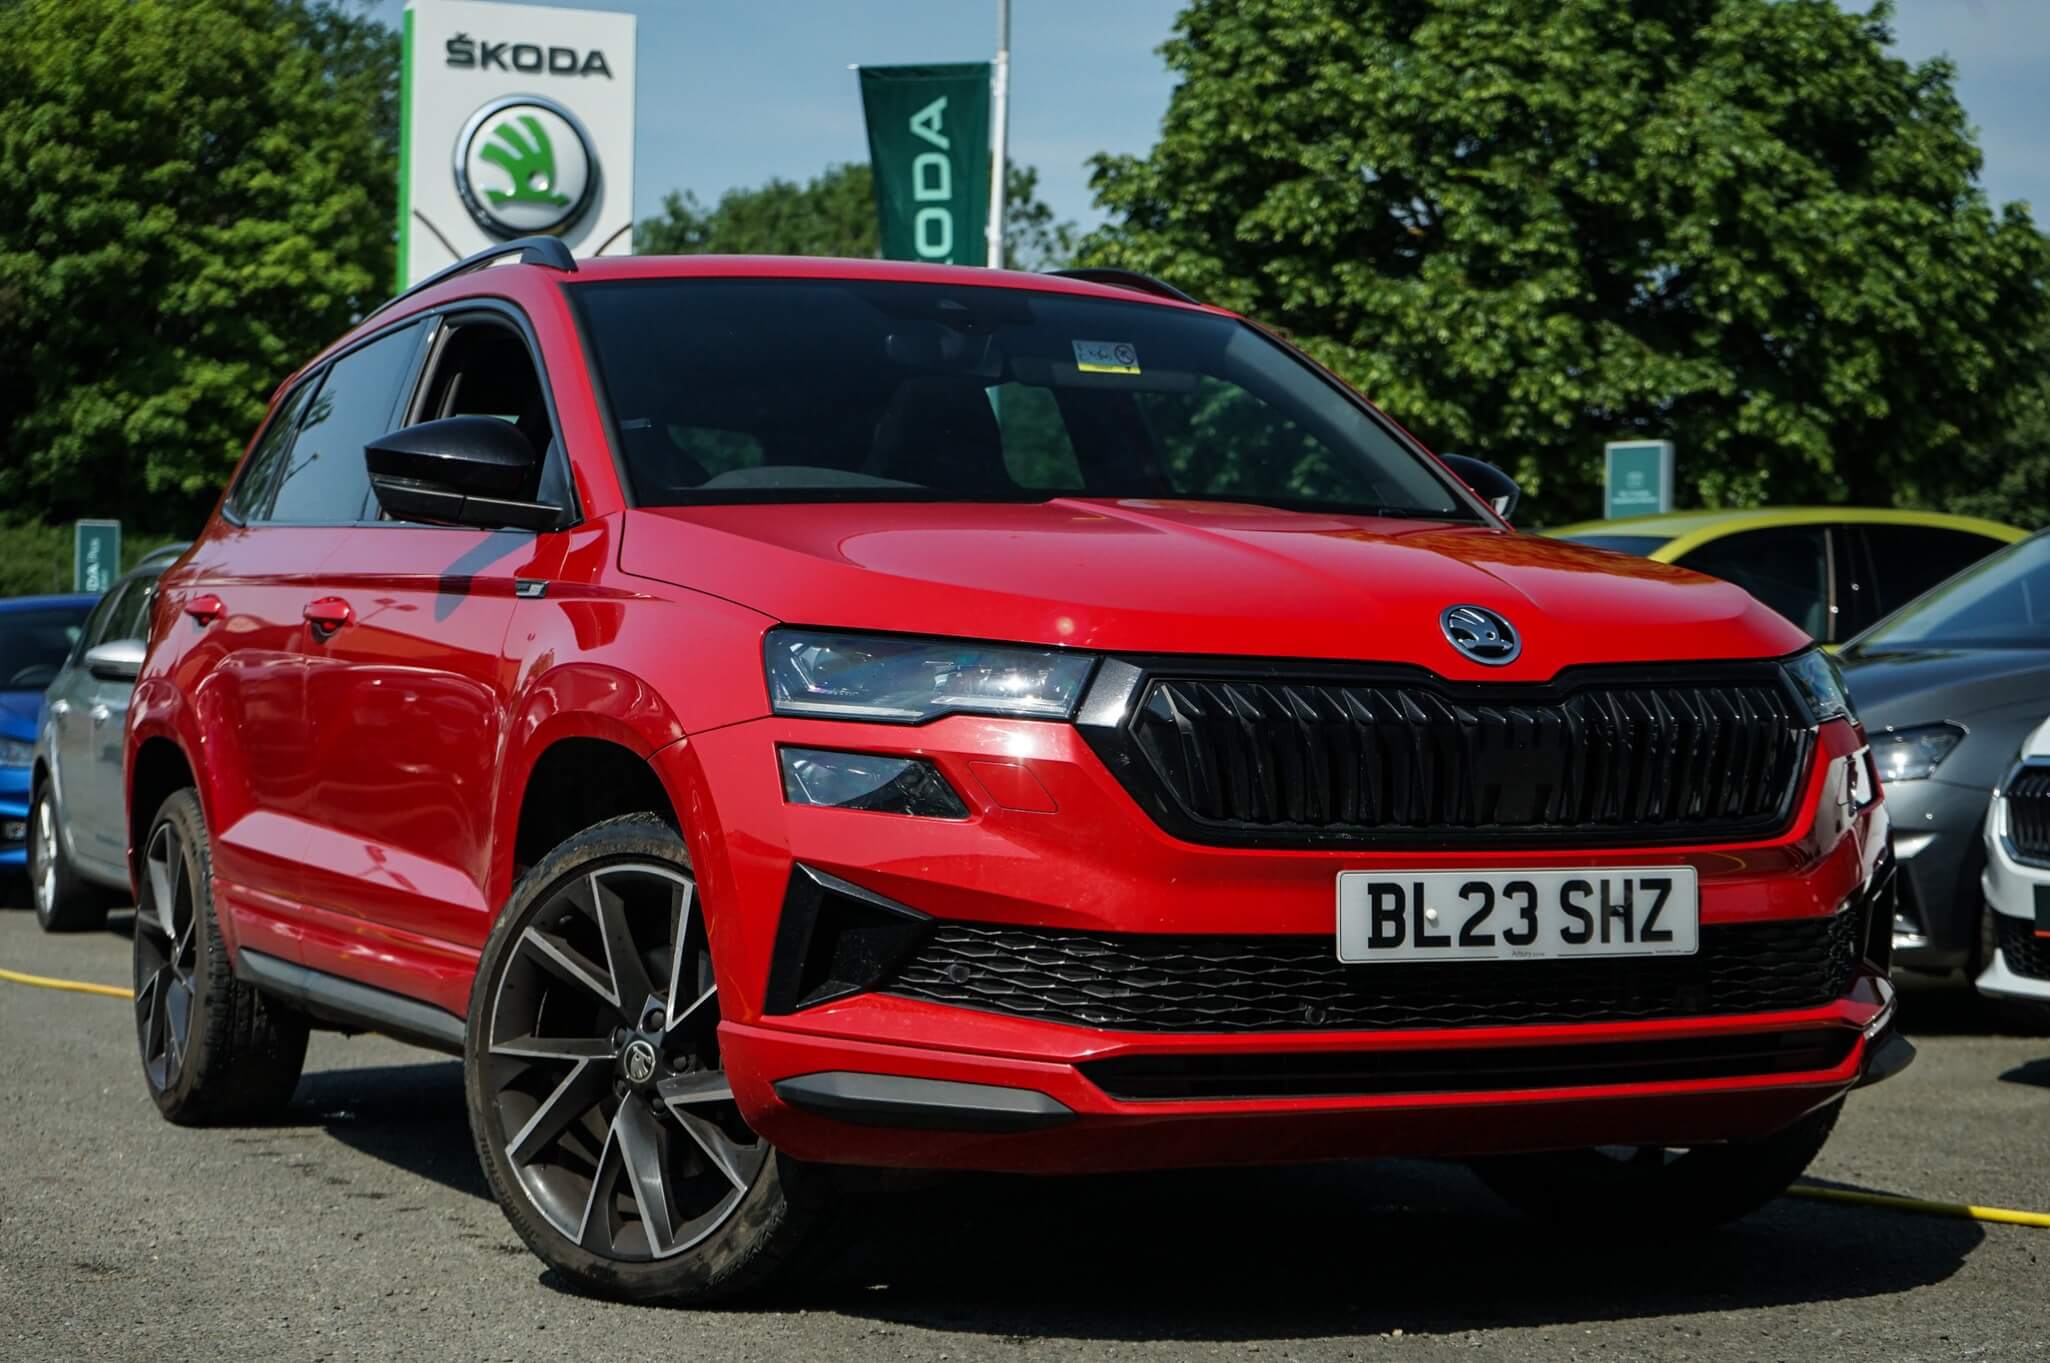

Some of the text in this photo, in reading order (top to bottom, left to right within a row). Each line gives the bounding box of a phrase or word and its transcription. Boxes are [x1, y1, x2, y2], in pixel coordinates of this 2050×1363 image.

[446, 32, 615, 79] ŠKODA
[909, 95, 954, 264] ODA
[1367, 878, 1674, 949] BL23 SHZ
